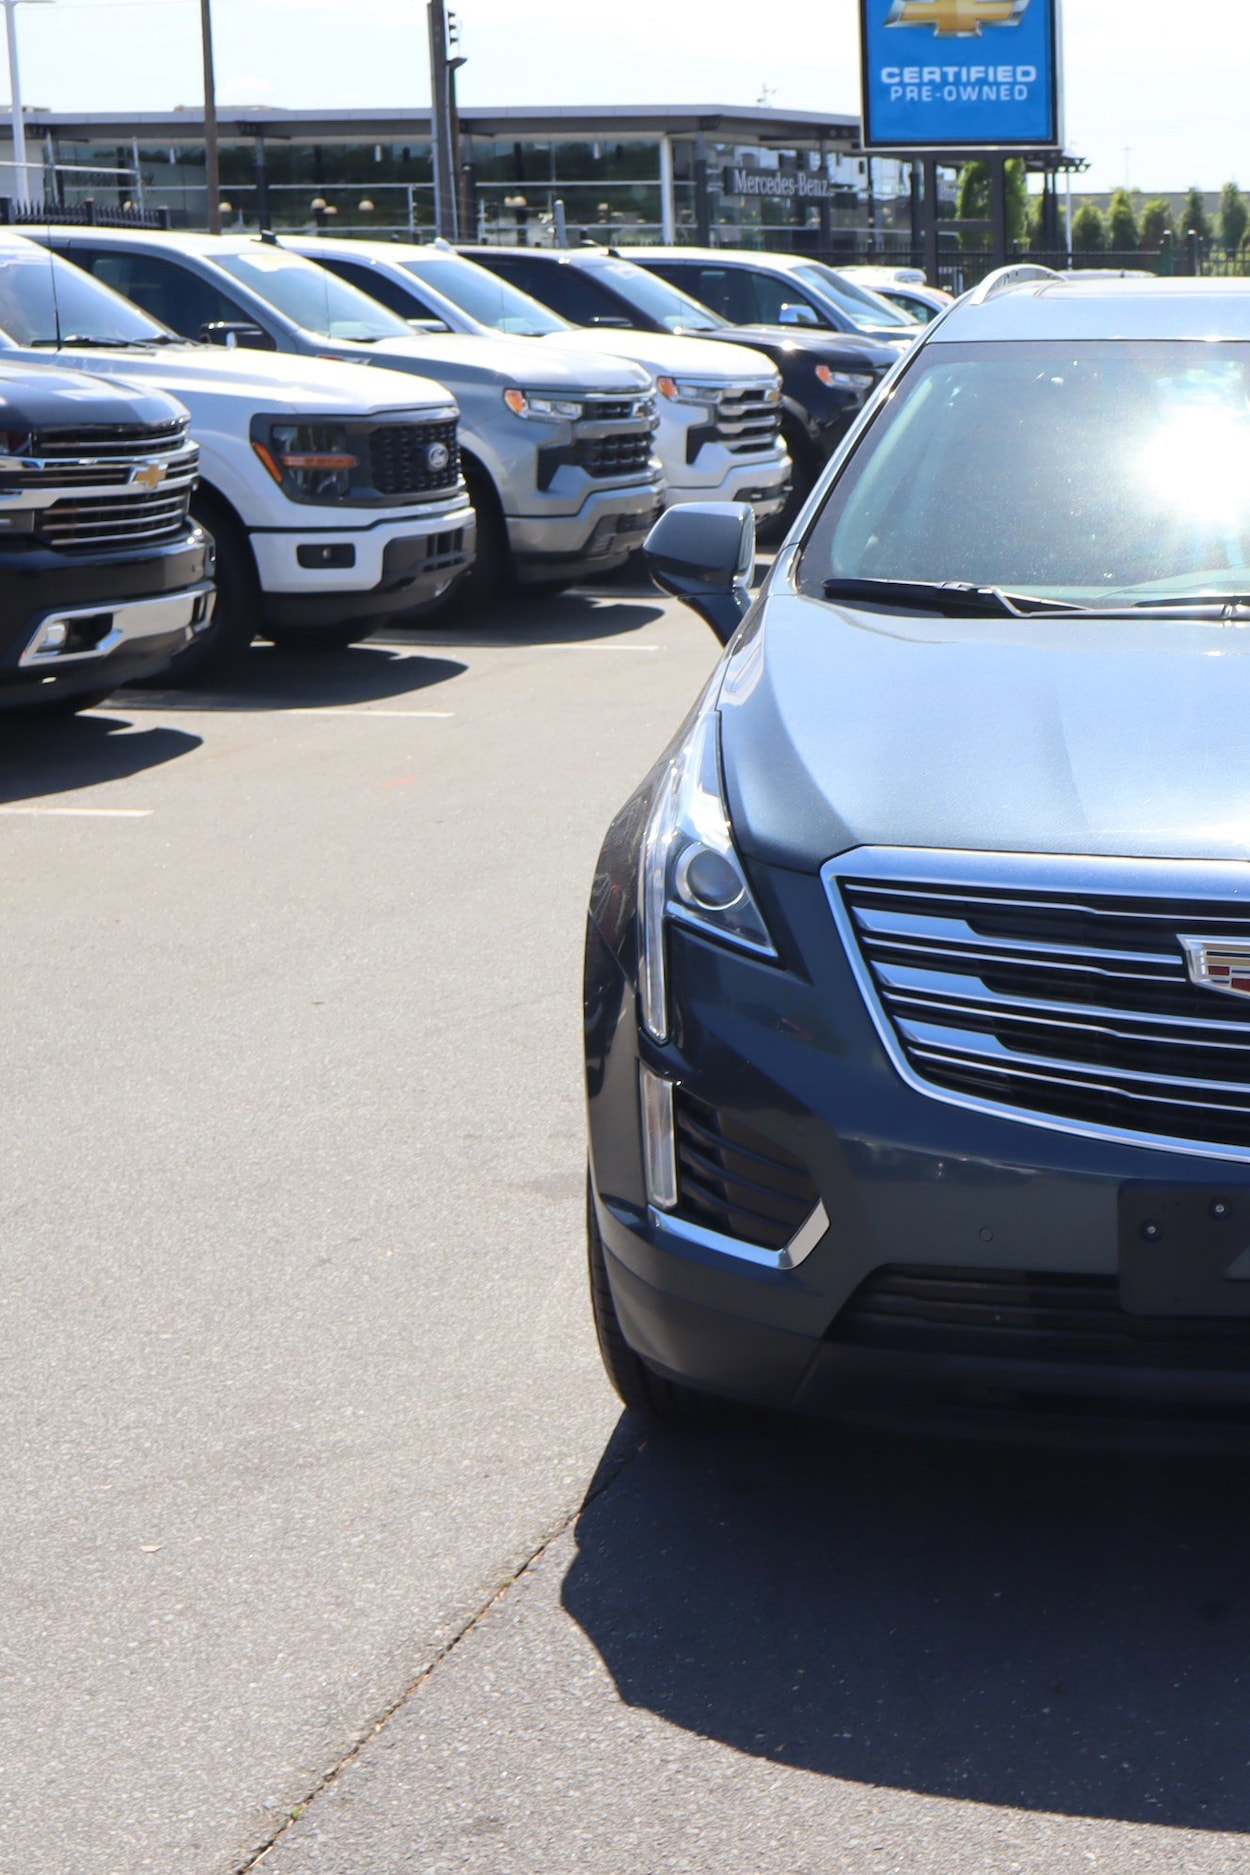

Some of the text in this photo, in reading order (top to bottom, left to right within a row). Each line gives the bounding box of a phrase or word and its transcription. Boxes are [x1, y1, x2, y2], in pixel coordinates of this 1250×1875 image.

[881, 65, 1037, 84] CERTIFIED
[890, 85, 1028, 102] PRE-OWNED
[733, 169, 829, 197] Mercedes-Benz
